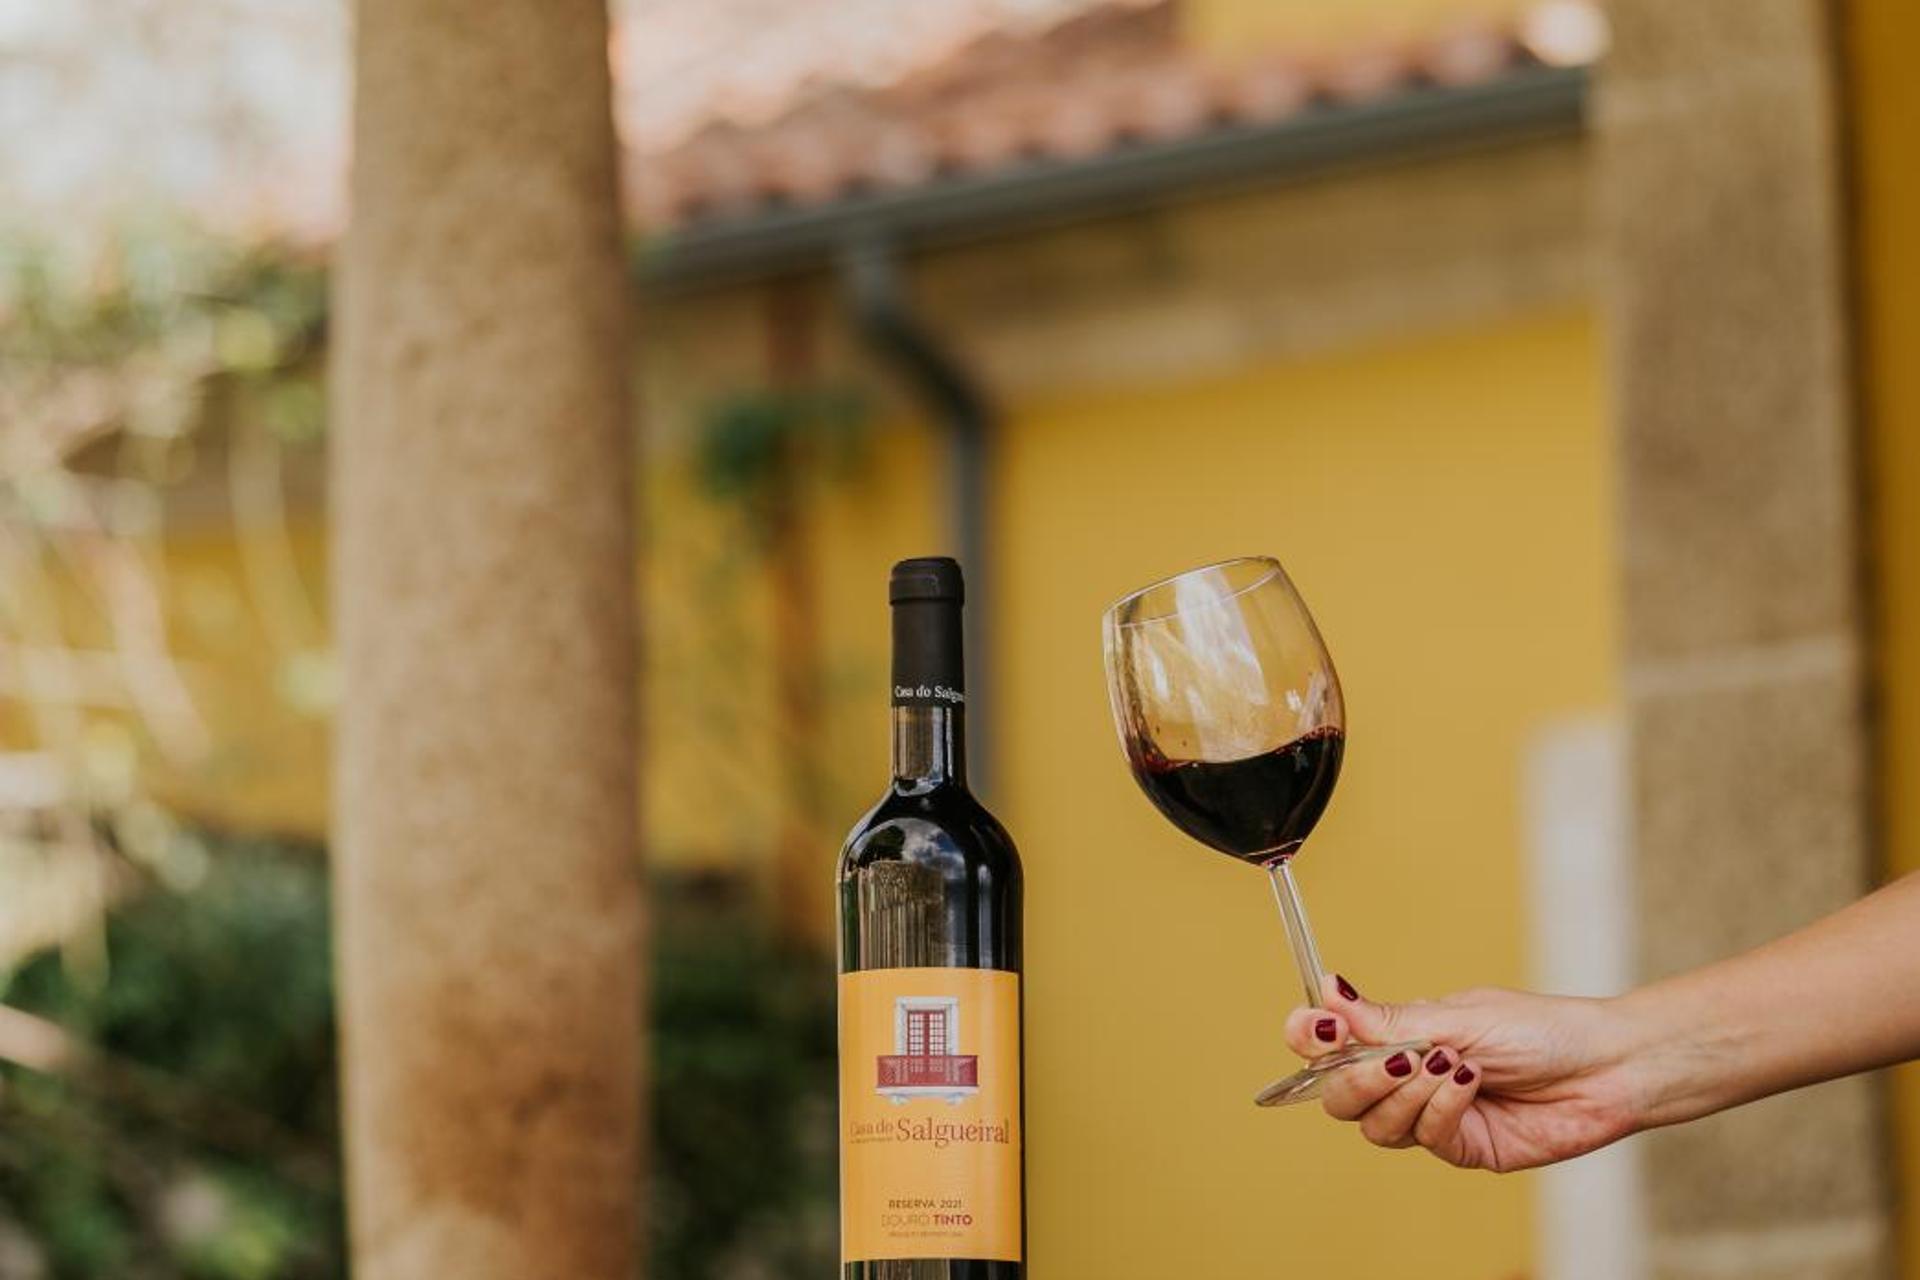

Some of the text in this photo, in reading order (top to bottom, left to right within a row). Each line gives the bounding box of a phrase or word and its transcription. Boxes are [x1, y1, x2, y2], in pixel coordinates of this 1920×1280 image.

[916, 684, 932, 698] do
[875, 1119, 894, 1134] do
[897, 1116, 1010, 1149] Salgueiral
[889, 1199, 962, 1209] RESERVA 2021
[933, 1214, 973, 1226] TINTO
